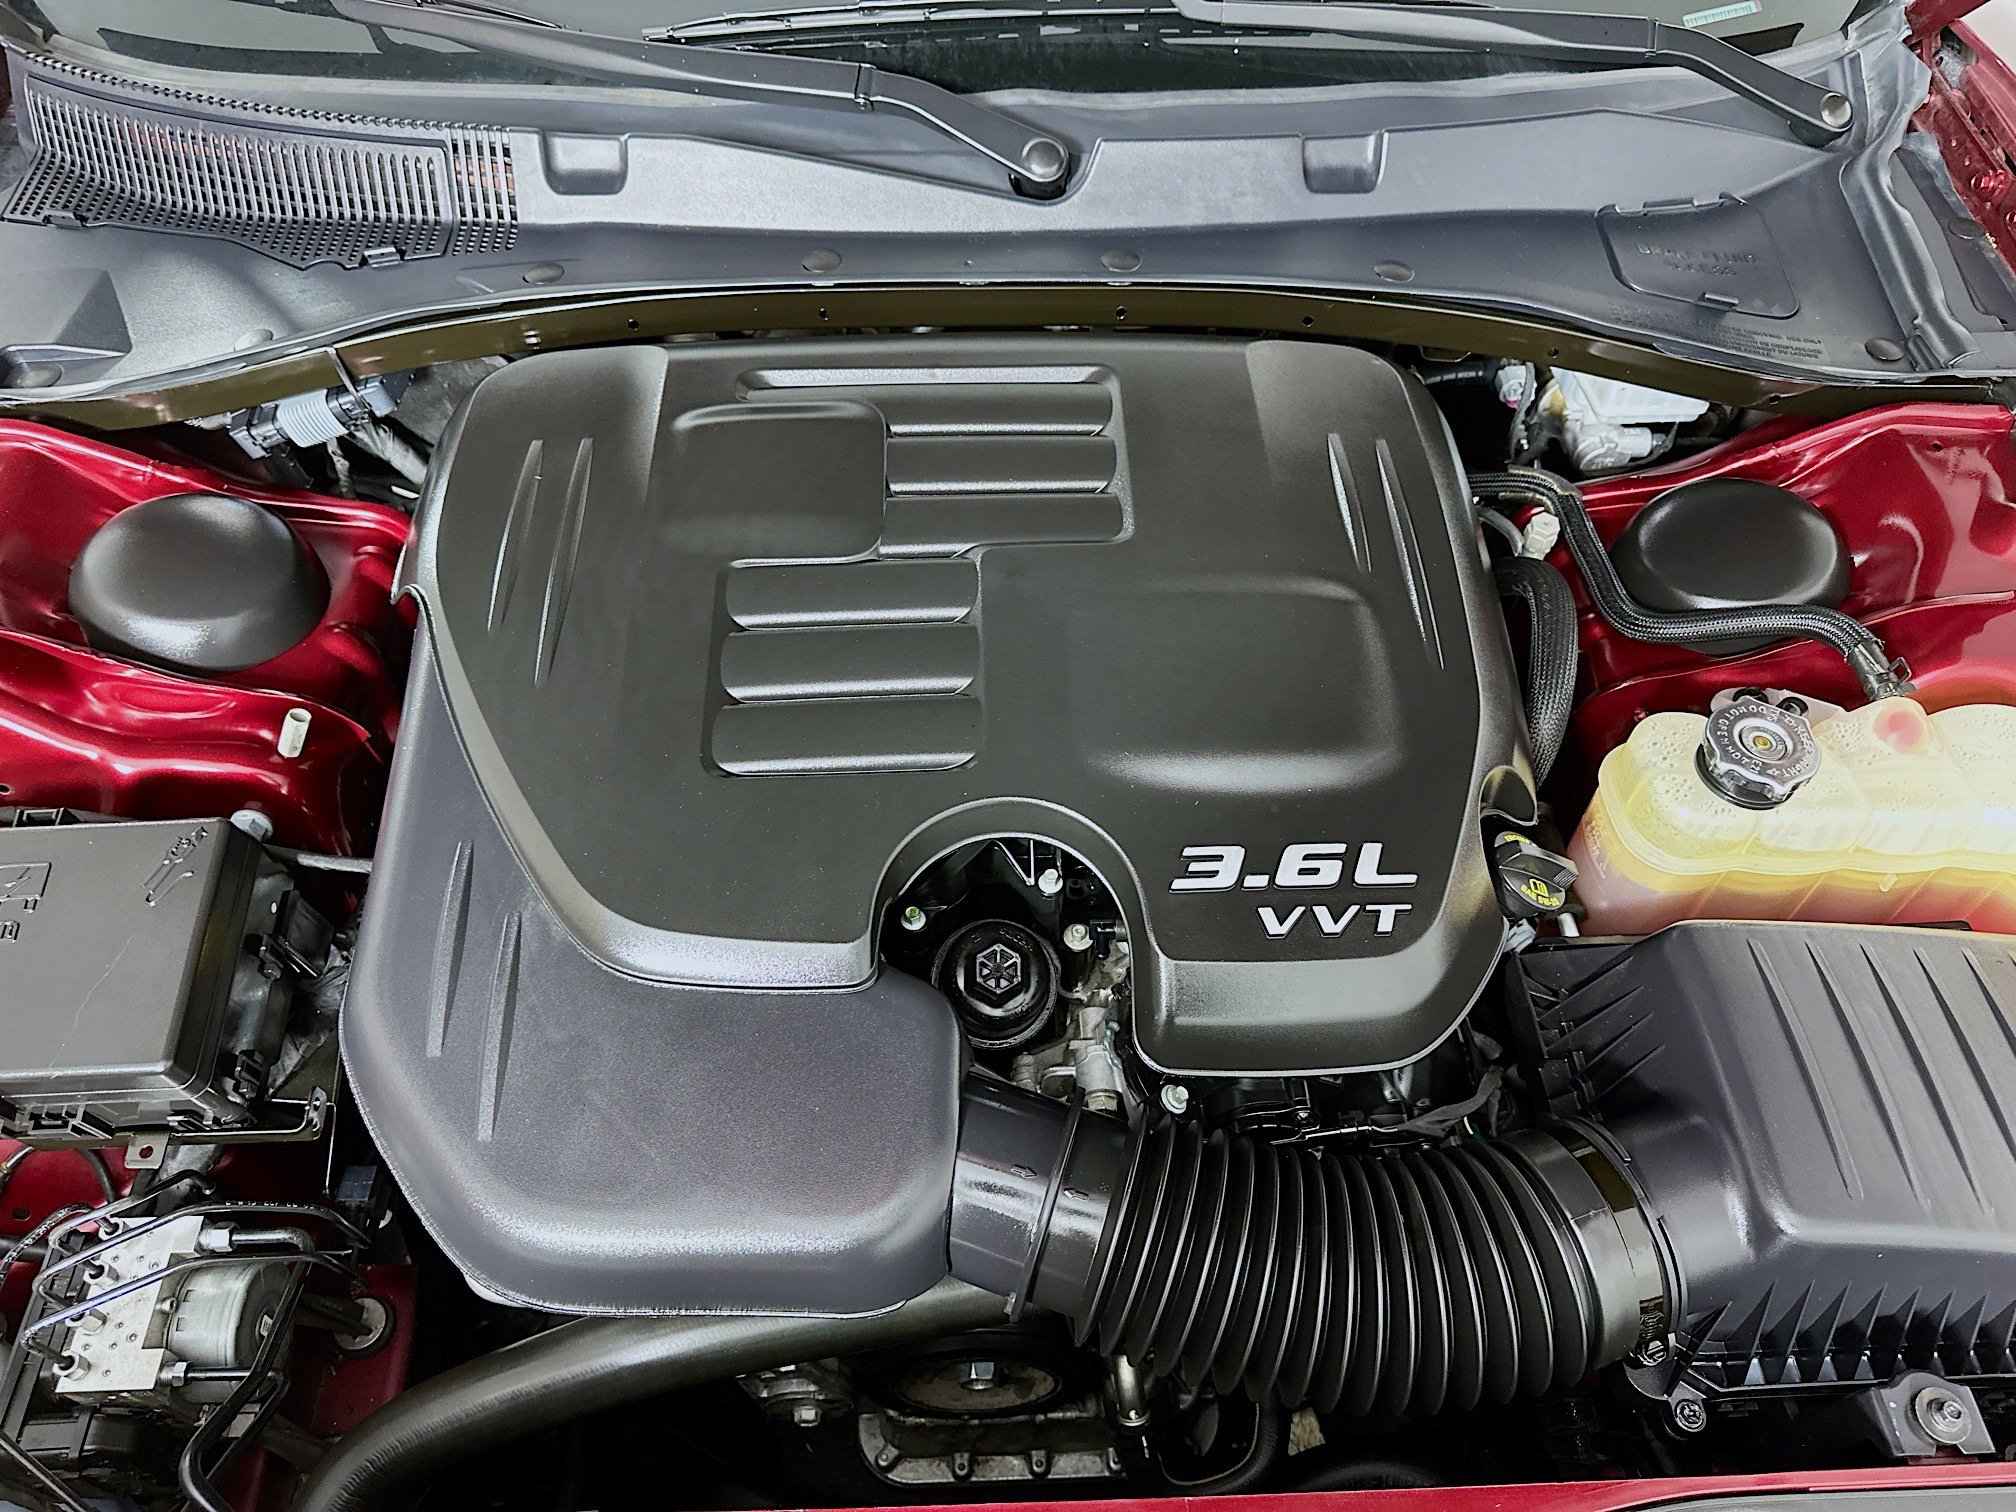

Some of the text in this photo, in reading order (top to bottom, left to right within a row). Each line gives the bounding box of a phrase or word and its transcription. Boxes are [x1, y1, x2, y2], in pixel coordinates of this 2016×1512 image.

[1726, 746, 1750, 764] HOT
[1169, 842, 1418, 893] 3.6L
[1257, 904, 1413, 939] VVT
